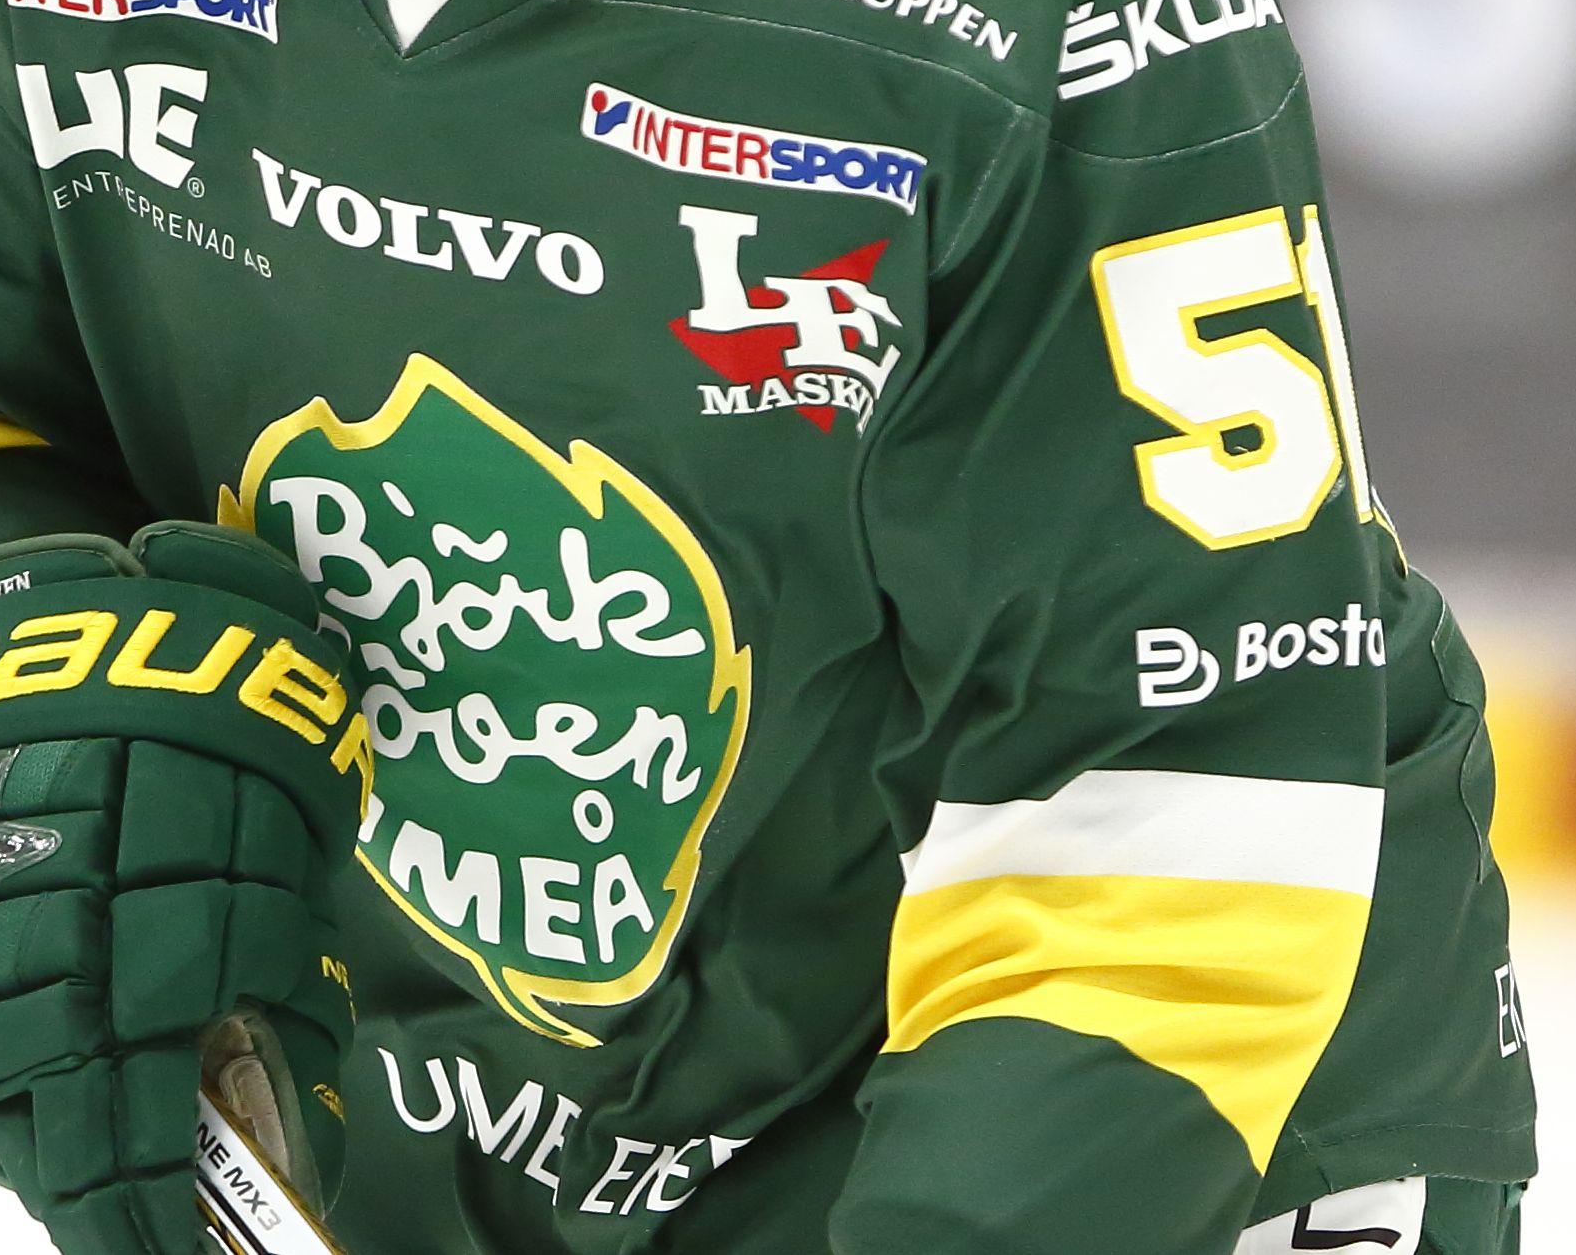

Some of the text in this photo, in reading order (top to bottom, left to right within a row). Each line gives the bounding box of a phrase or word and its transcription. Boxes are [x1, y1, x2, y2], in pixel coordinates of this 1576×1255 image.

[632, 106, 923, 204] INTERSPORT
[244, 248, 272, 279] AB
[251, 148, 606, 296] VOLVO
[196, 1121, 282, 1232] NE MX3
